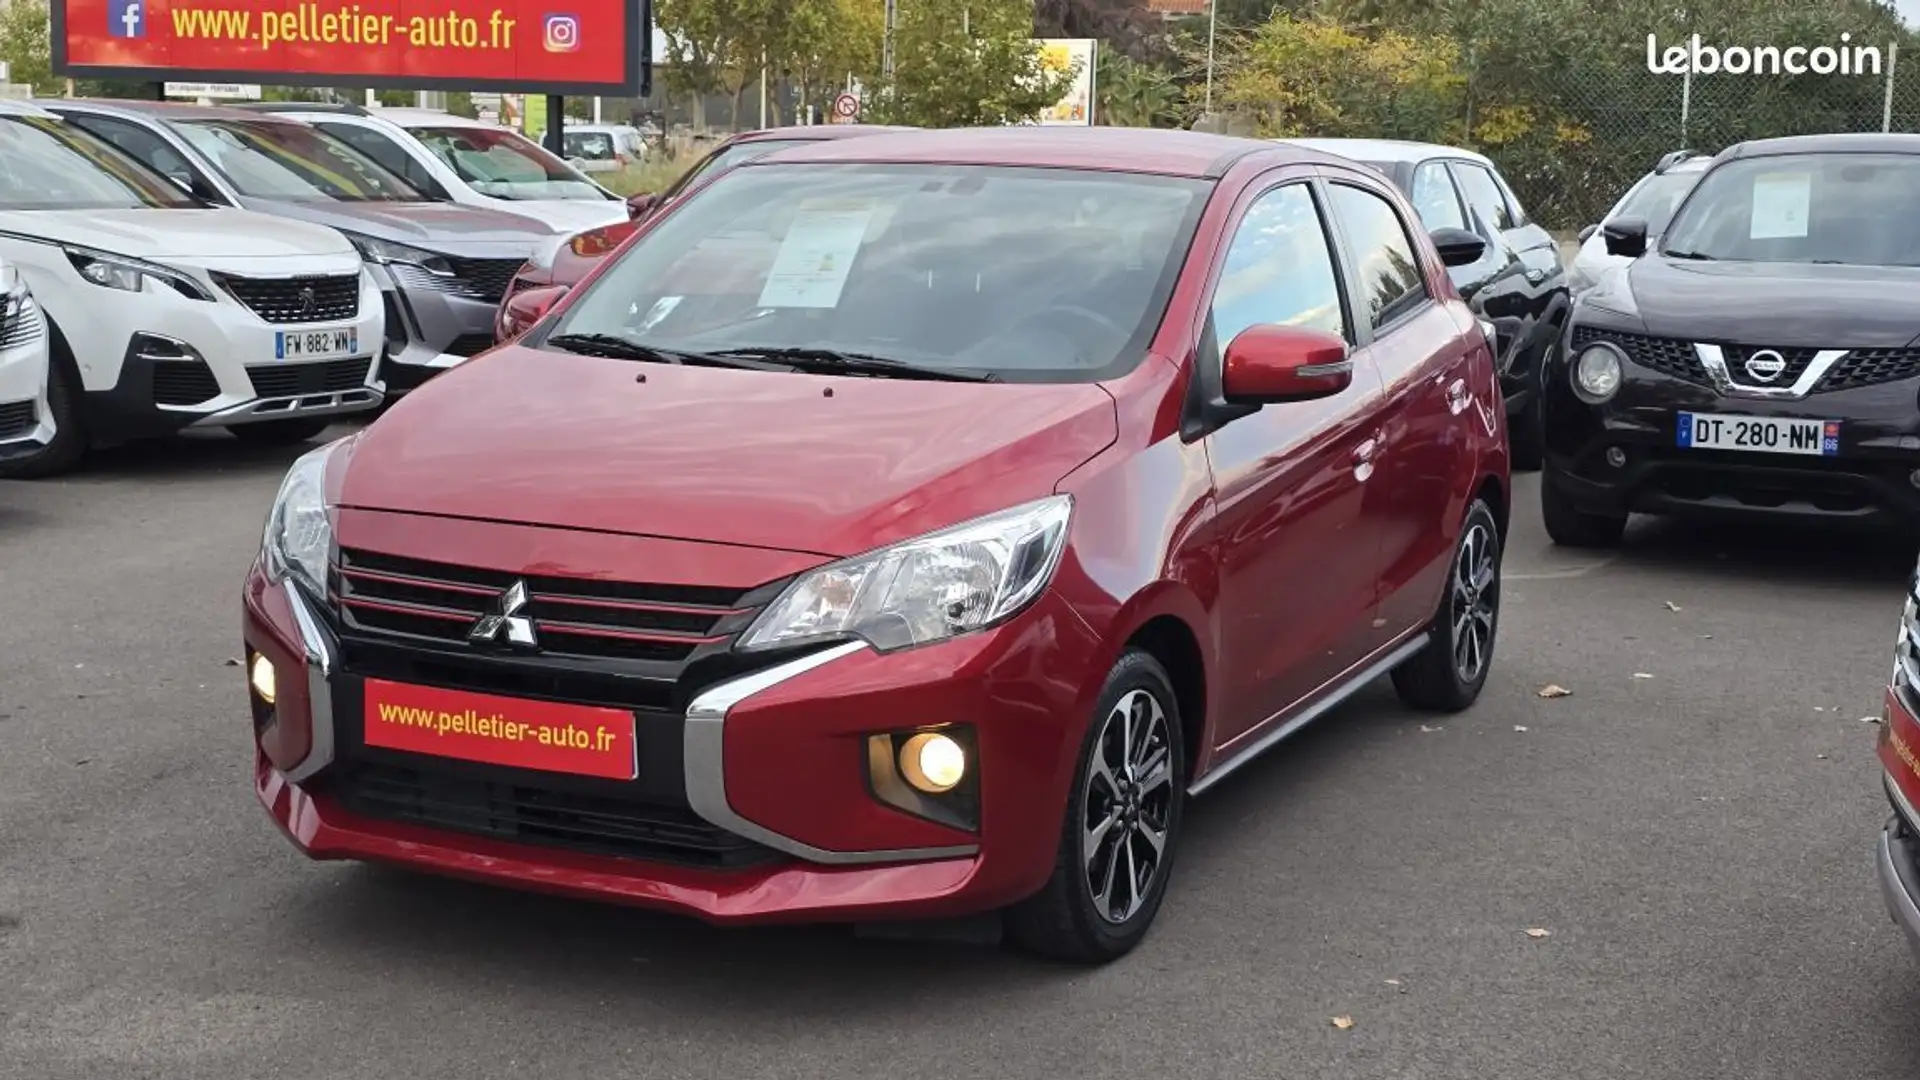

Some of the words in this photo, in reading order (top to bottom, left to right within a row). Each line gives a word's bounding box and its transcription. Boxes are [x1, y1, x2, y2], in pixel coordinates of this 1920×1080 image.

[172, 4, 515, 50] www.pelletier-auto.fr
[1696, 419, 1818, 449] DT-280-NM
[1824, 438, 1838, 450] 66
[379, 703, 616, 752] www.pelletier-auto.fr
